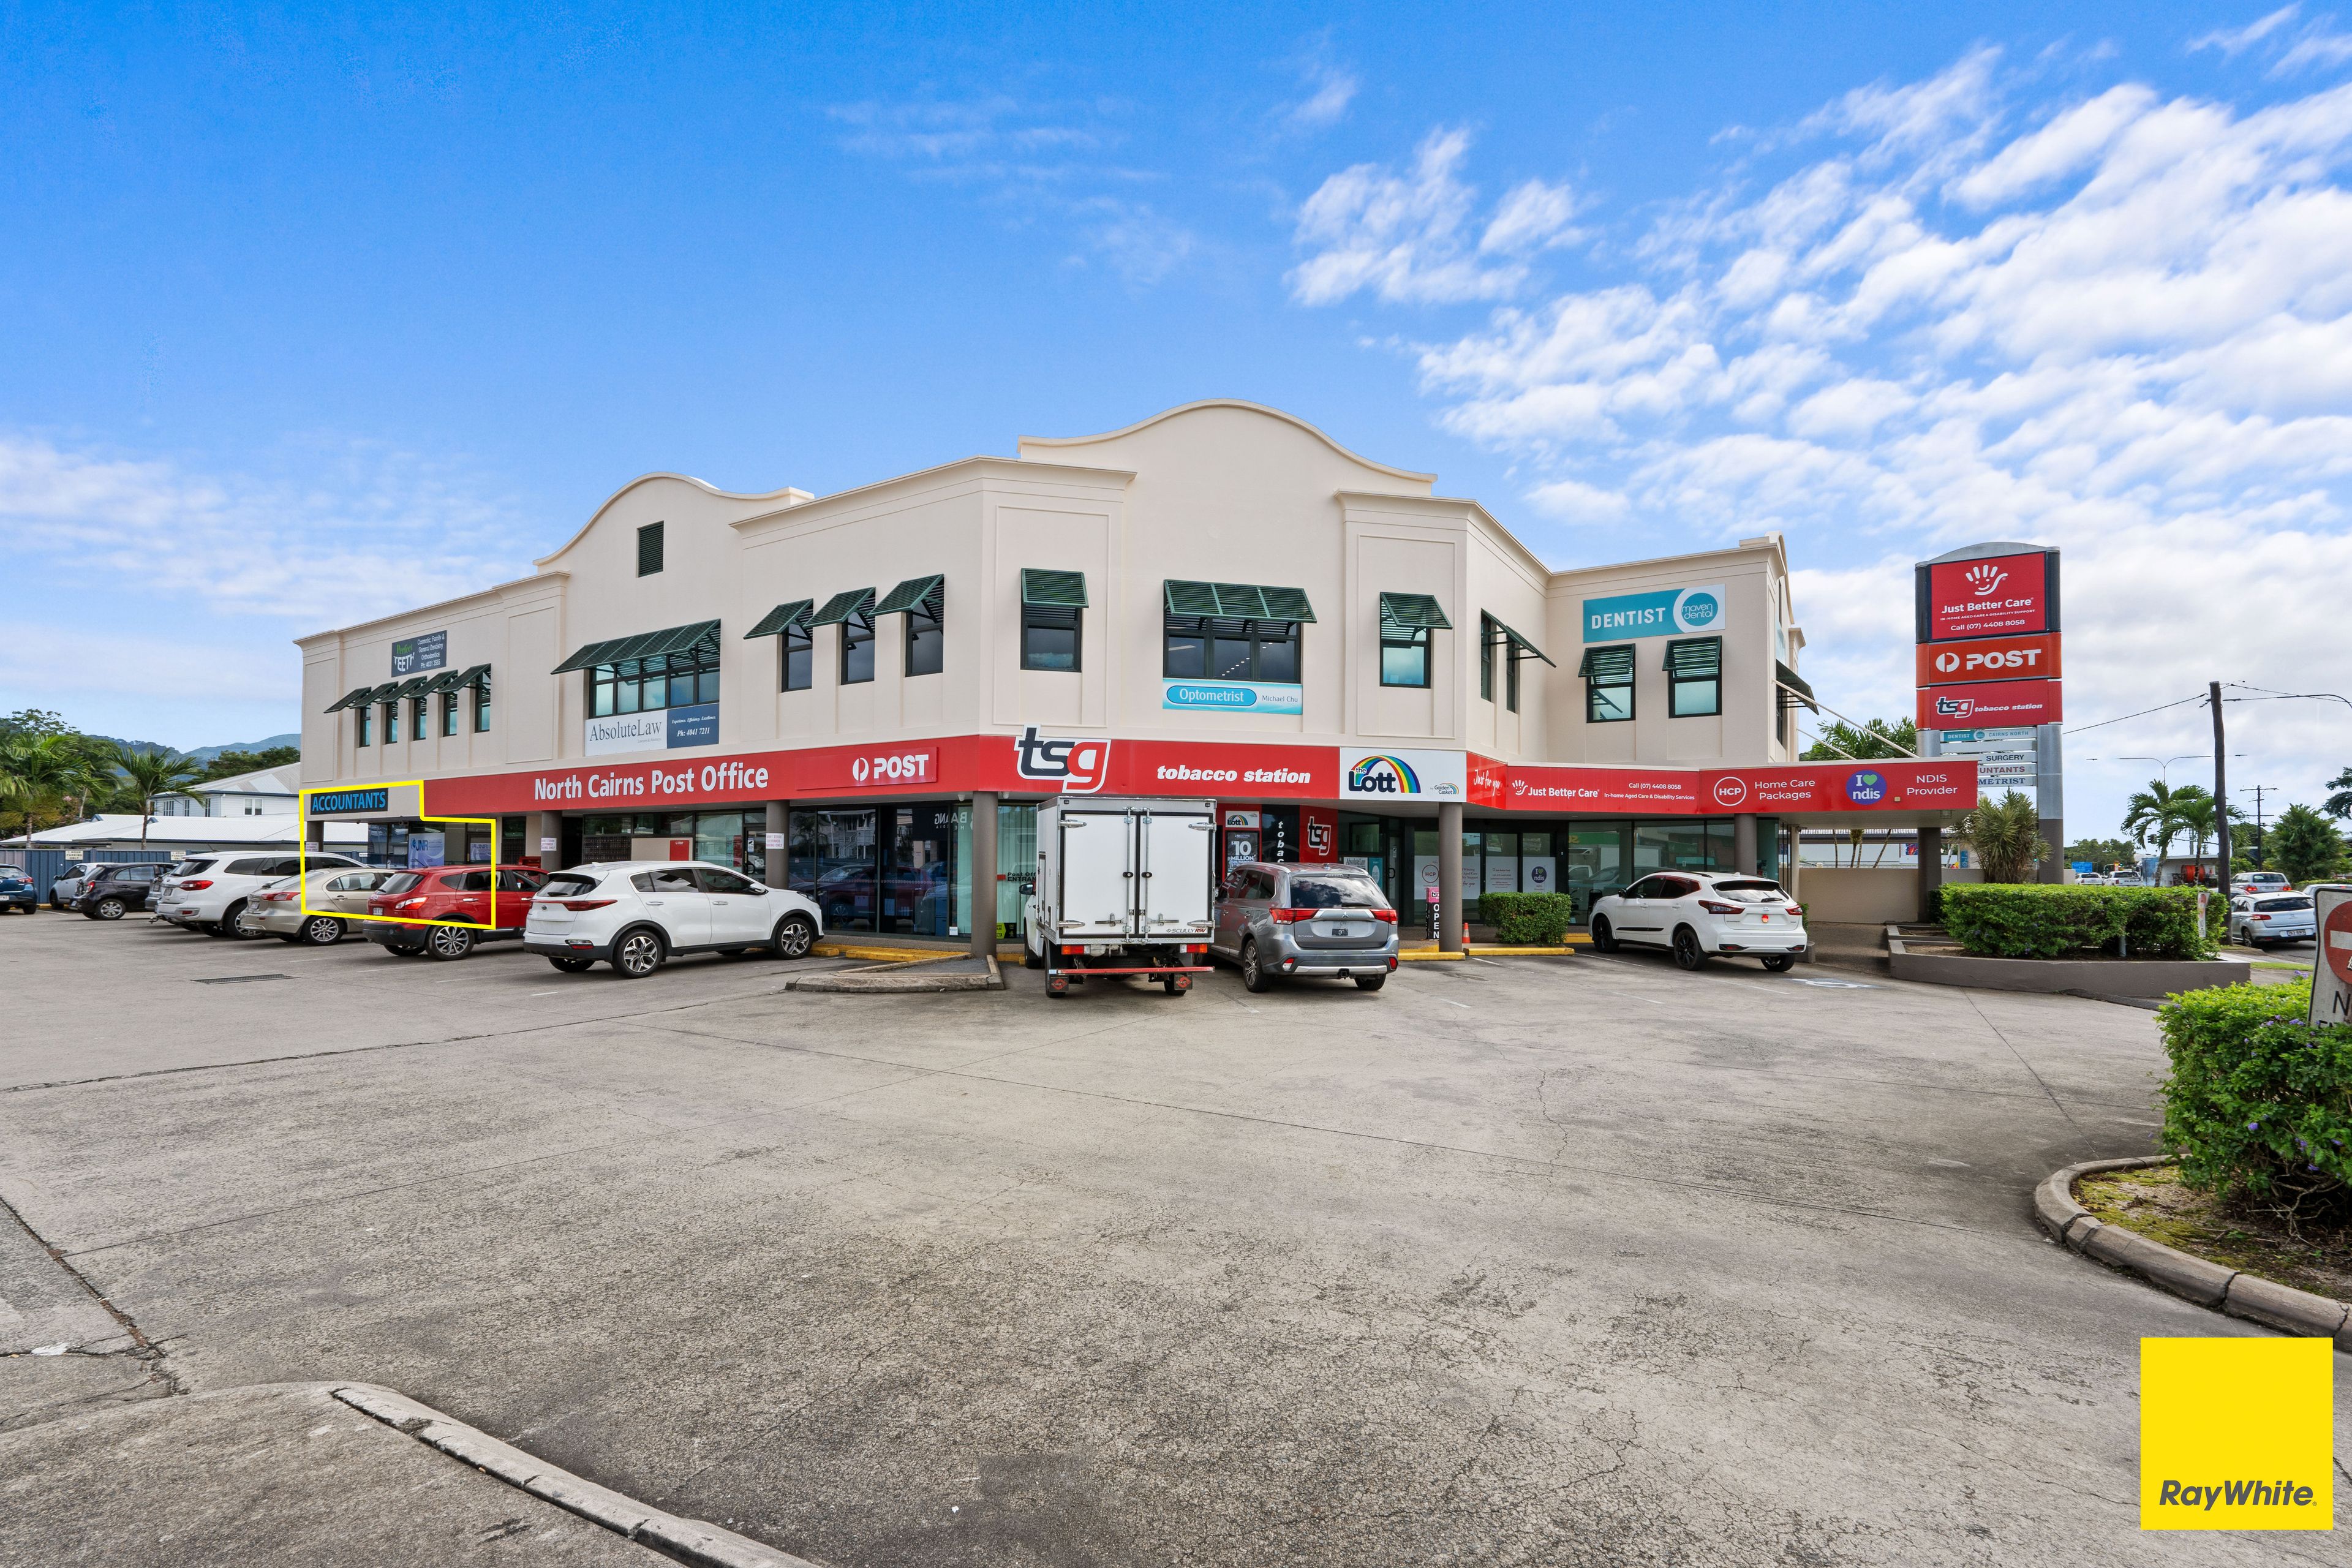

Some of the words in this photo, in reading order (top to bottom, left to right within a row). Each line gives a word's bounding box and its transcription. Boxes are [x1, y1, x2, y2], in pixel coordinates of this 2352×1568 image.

[1681, 603, 1713, 613] maven
[1684, 609, 1713, 620] dental
[1942, 605, 1964, 614] Just
[1967, 601, 2002, 611] Better
[2005, 598, 2032, 608] Care
[1591, 607, 1666, 630] DENTIST
[393, 652, 415, 672] TEETH
[1966, 649, 2041, 671] POST
[1180, 687, 1244, 703] Optometrist
[1936, 696, 1975, 718] tsg
[1975, 704, 2010, 712] tobacco
[873, 754, 929, 780] POST
[1018, 726, 1105, 793] tsg
[534, 774, 582, 800] North
[587, 772, 644, 797] Cairns
[651, 767, 695, 794] Post
[701, 761, 769, 792] Office
[1157, 764, 1237, 782] tobacco
[1243, 767, 1311, 784] station
[1349, 771, 1396, 793] Lott
[1474, 769, 1485, 785] Just
[1492, 780, 1501, 796] you
[1754, 780, 1787, 790] Home
[1790, 778, 1815, 788] Care
[1916, 774, 1948, 784] NDIS
[1528, 786, 1547, 796] Just
[1548, 787, 1577, 797] Better
[1578, 788, 1599, 797] Care
[1758, 790, 1812, 801] Packages
[1852, 788, 1881, 800] ndis
[1906, 785, 1958, 796] Provider
[312, 791, 386, 812] ACCOUNTANTS
[1307, 816, 1332, 856] tsg
[2332, 990, 2351, 1017] N
